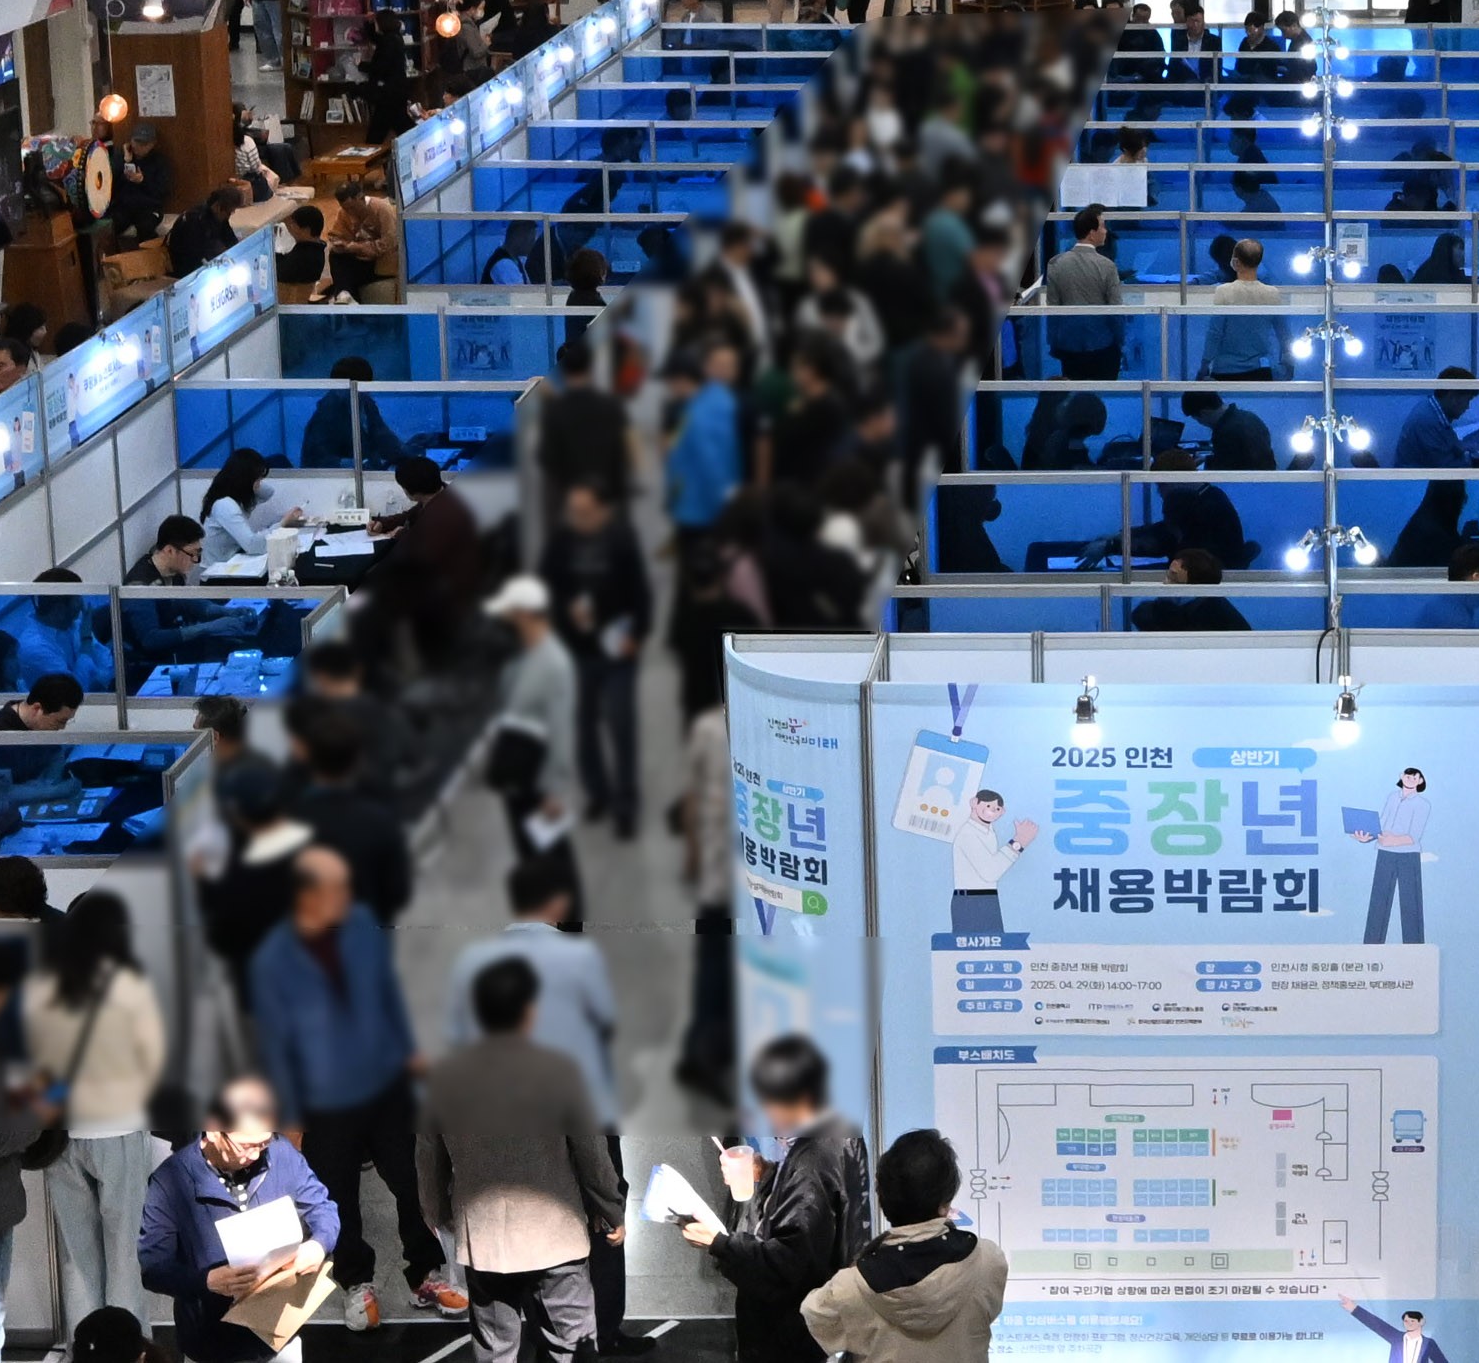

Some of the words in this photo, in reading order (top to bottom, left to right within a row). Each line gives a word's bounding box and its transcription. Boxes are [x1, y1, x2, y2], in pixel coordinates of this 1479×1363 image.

[1051, 747, 1117, 768] 2025
[1125, 746, 1173, 769] 인천
[1230, 749, 1280, 766] 상반기
[1051, 779, 1320, 857] 중장년
[741, 832, 829, 886] 용박람회
[1052, 866, 1320, 915] 채용박람회
[959, 1050, 1015, 1061] 부스배치도
[1073, 1286, 1113, 1296] 구인기업
[1150, 1285, 1171, 1295] 따라
[1208, 1285, 1228, 1295] 조기
